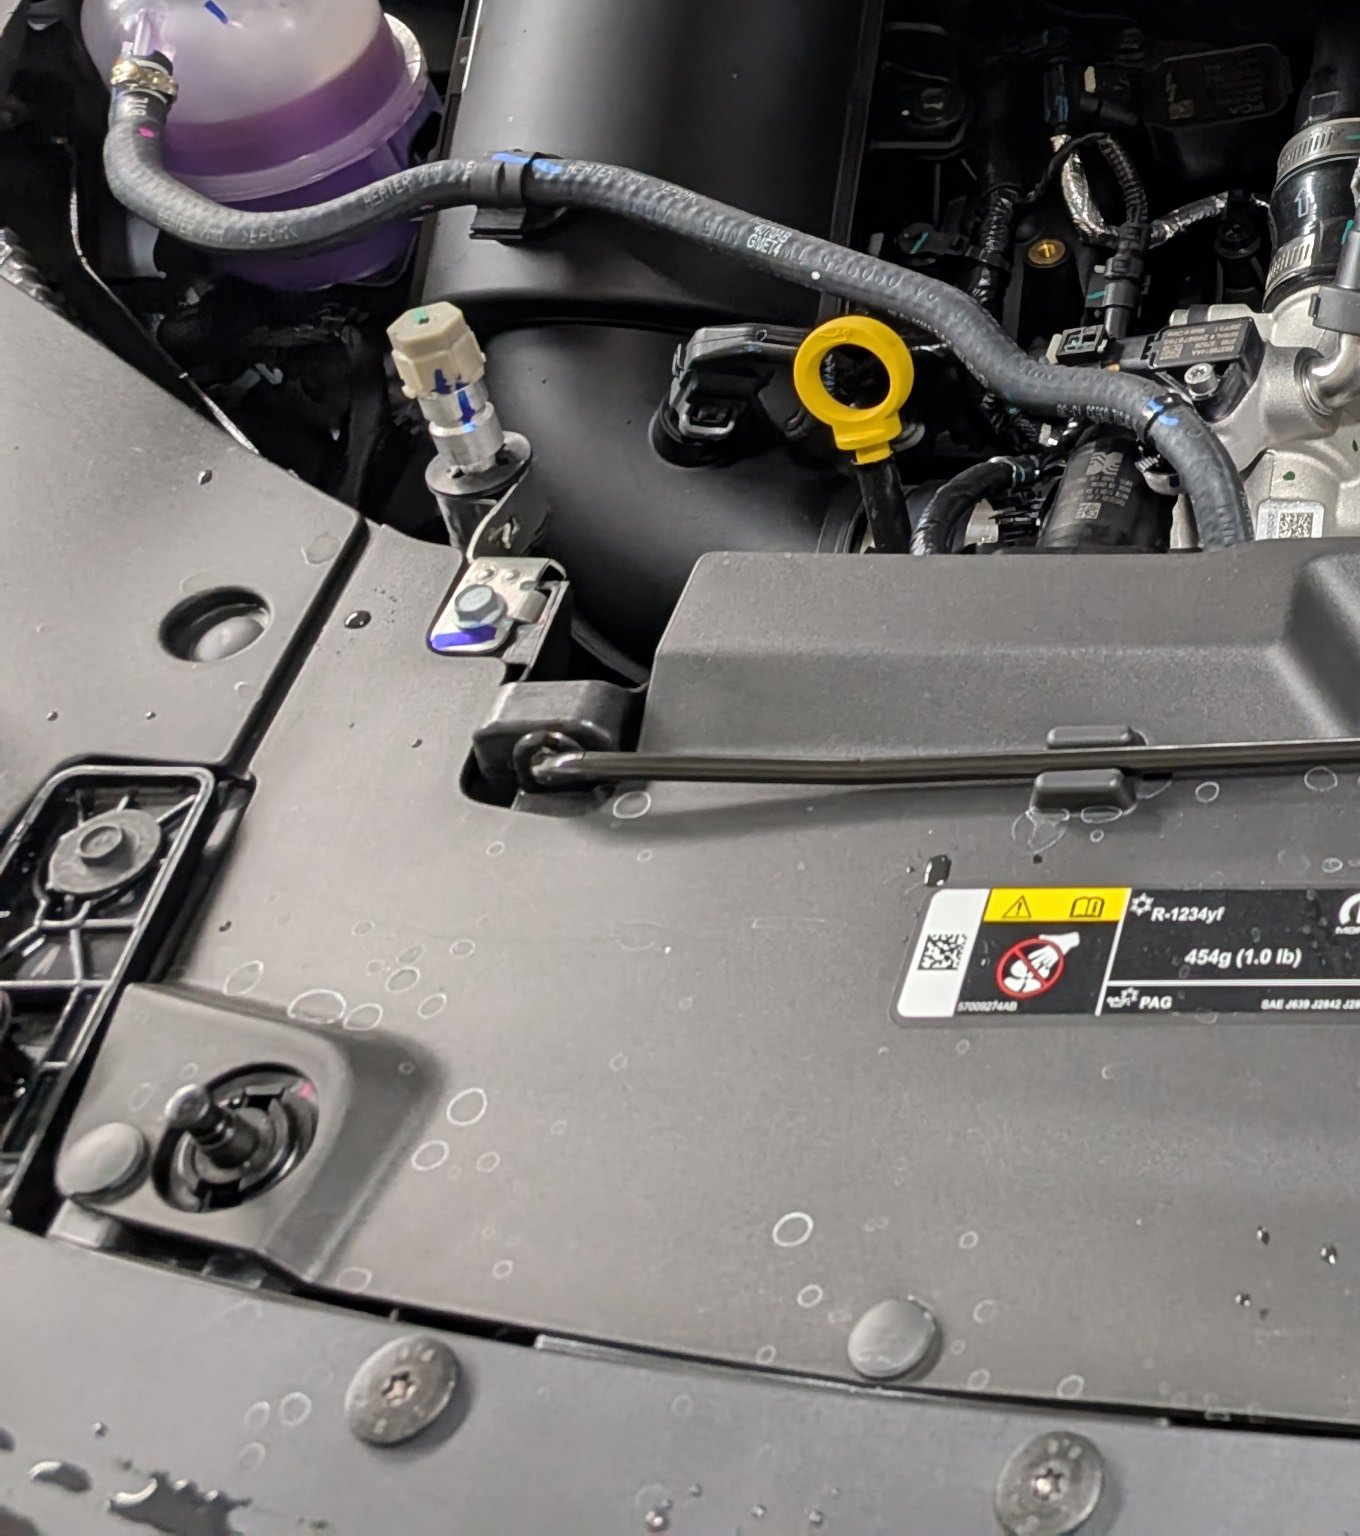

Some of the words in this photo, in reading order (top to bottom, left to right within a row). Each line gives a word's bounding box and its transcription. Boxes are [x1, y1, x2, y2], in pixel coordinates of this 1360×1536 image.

[1151, 906, 1225, 924] R-1234yf
[1184, 948, 1232, 969] 454g
[1236, 948, 1272, 969] (1.0
[1276, 948, 1302, 969] lb)
[1139, 996, 1173, 1009] PAG
[1261, 999, 1284, 1010] SAE
